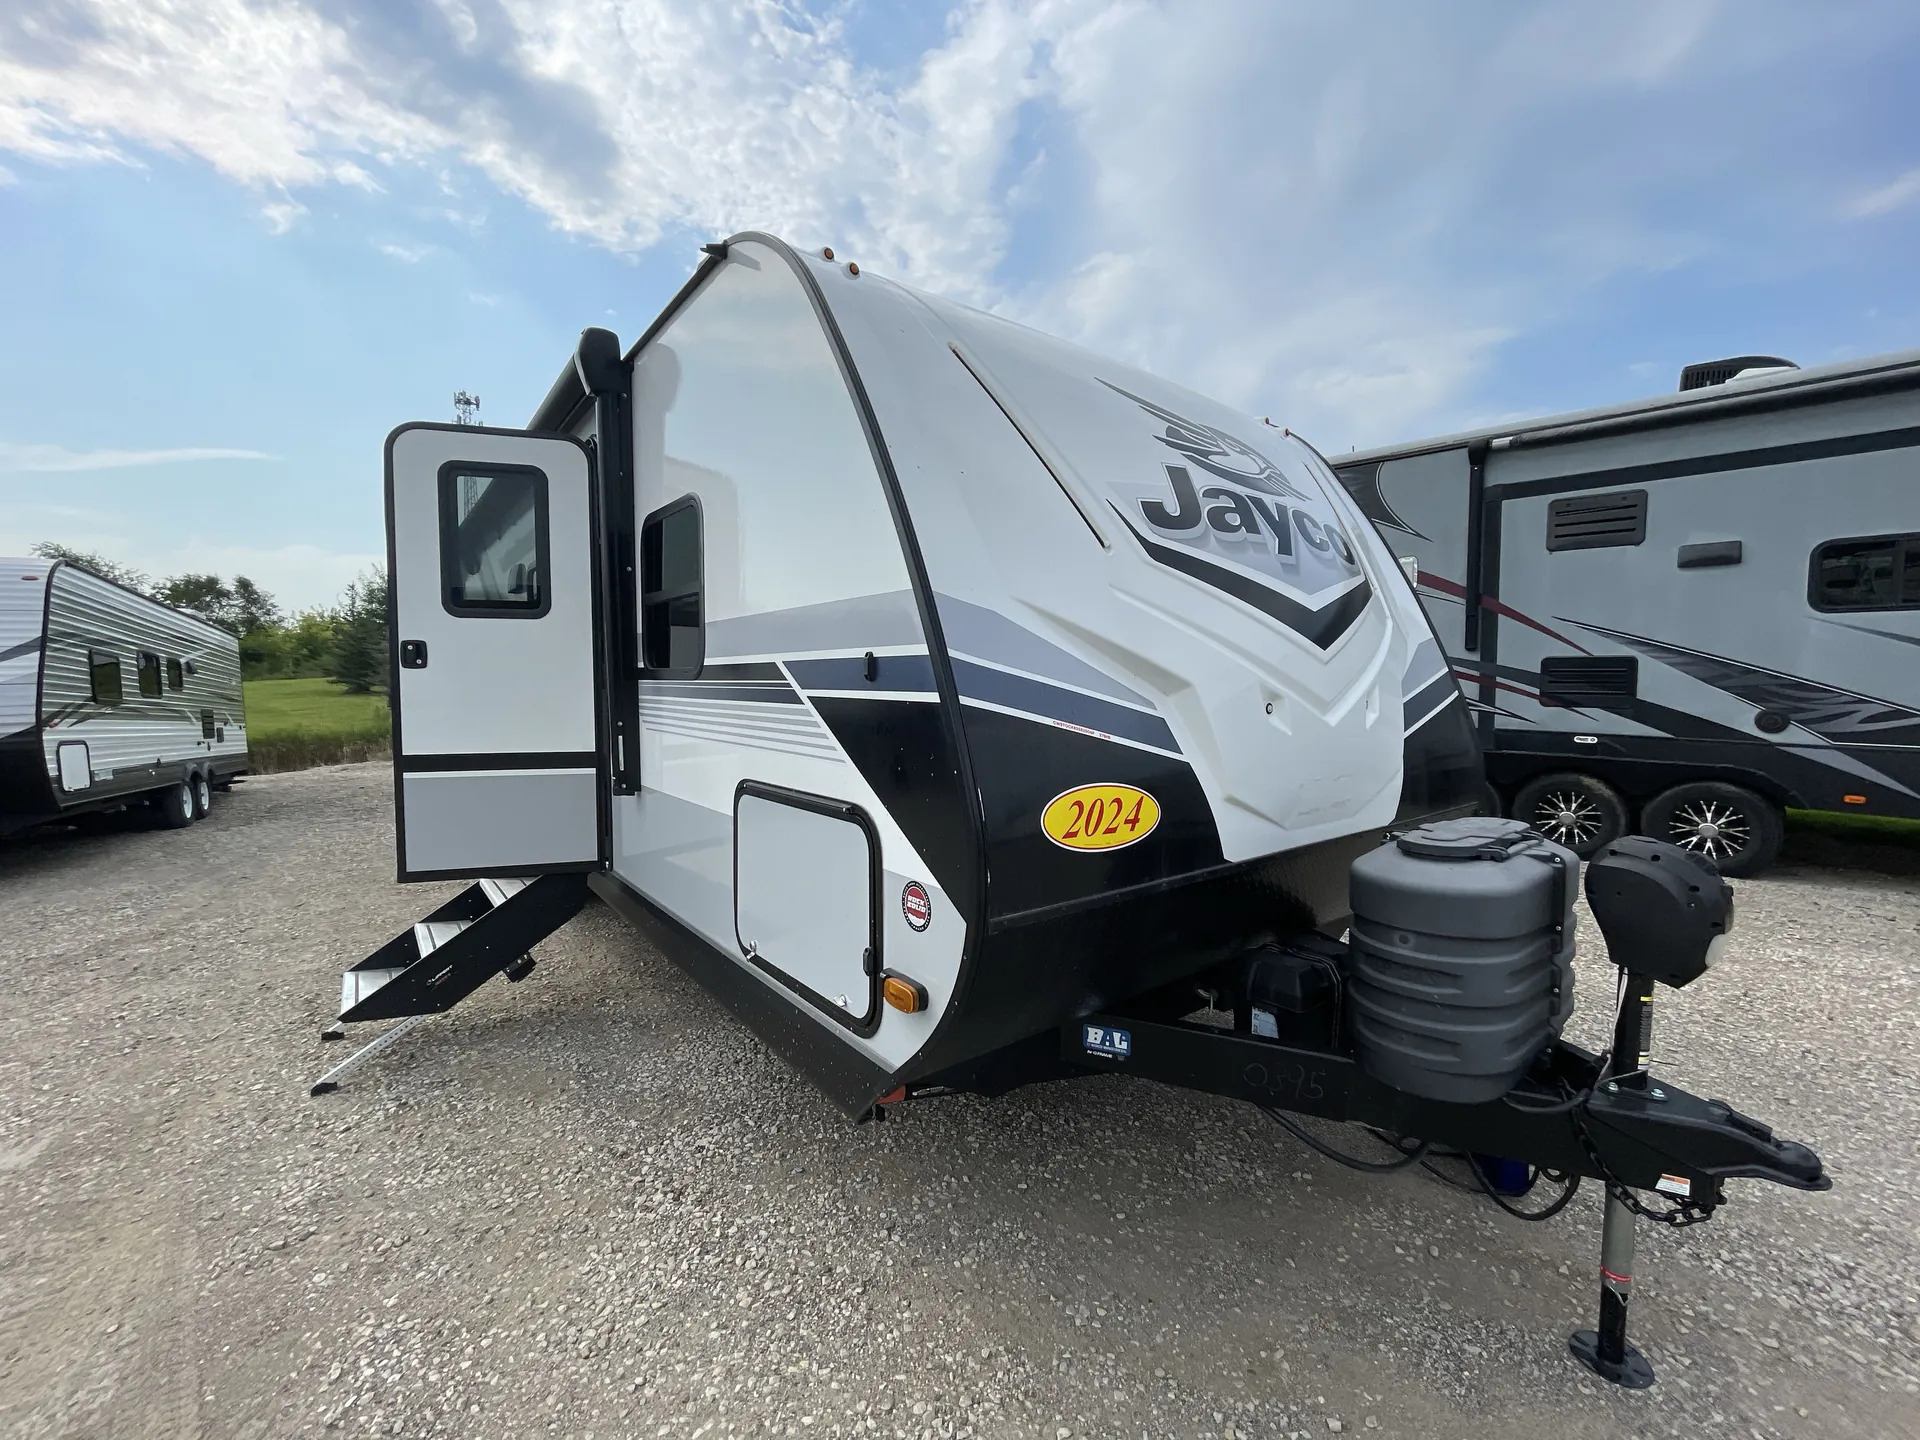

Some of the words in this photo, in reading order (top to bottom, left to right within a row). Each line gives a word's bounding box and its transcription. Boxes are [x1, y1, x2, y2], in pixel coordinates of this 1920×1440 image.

[1138, 462, 1356, 566] Jayco
[1062, 796, 1144, 839] 2024
[906, 902, 927, 913] SOLID
[907, 895, 925, 907] ROCK
[1087, 1027, 1128, 1049] BAL
